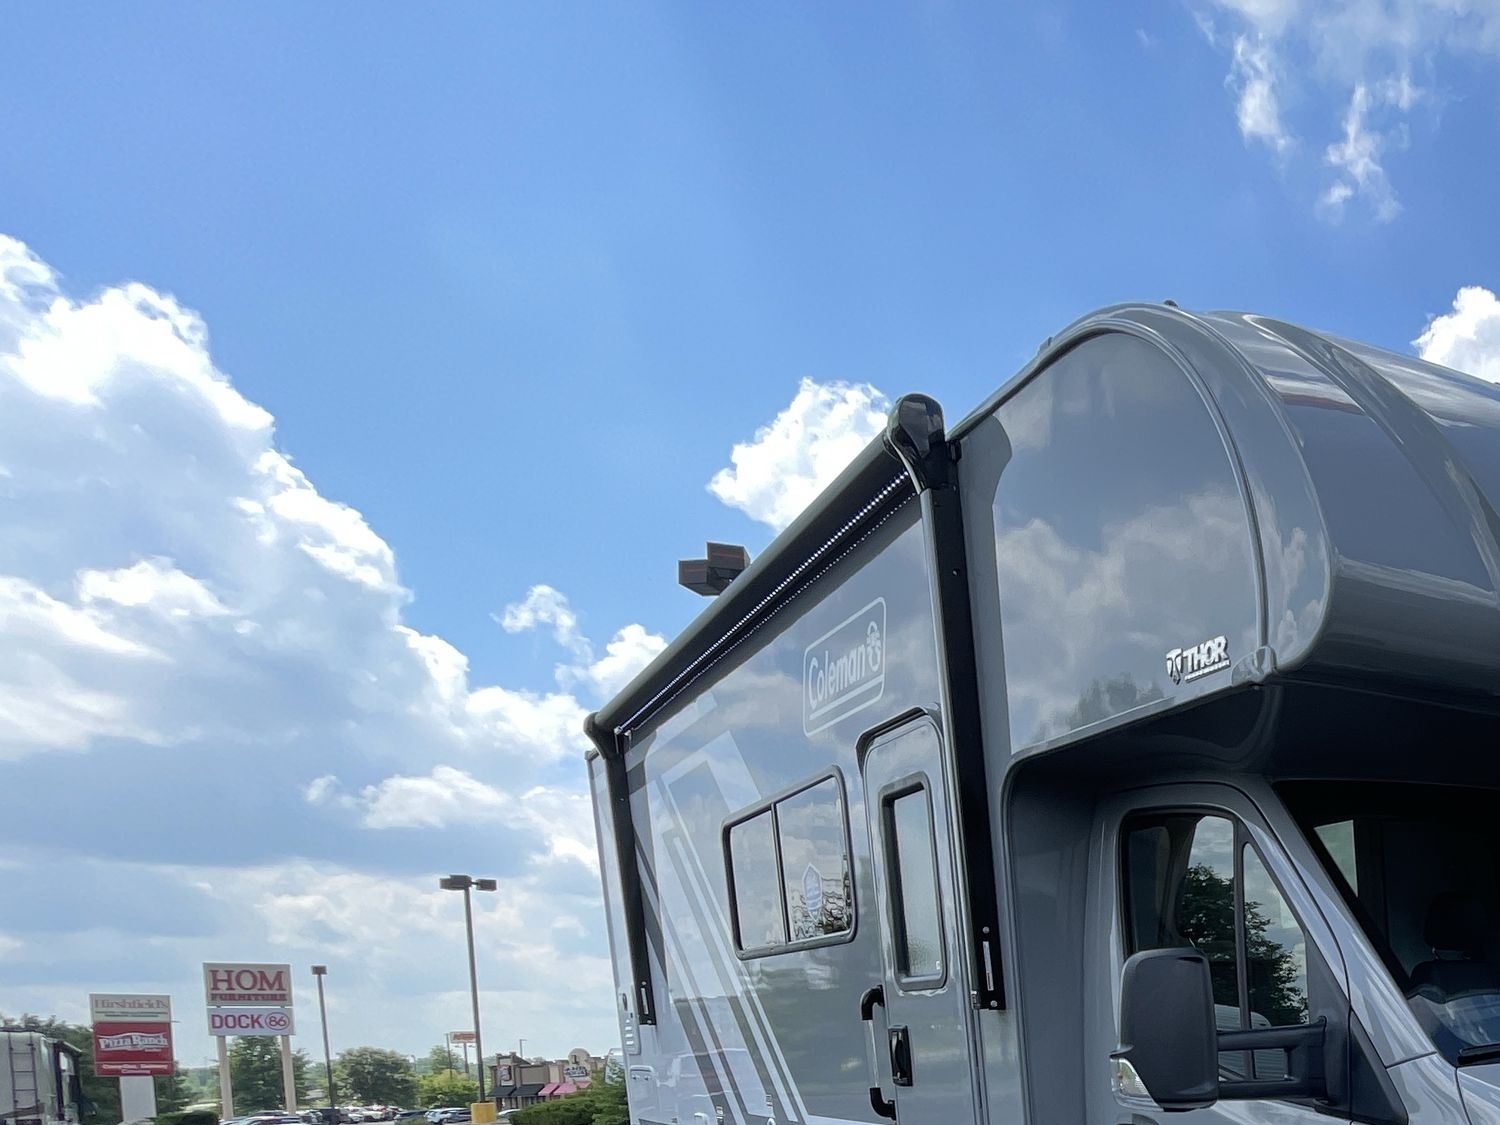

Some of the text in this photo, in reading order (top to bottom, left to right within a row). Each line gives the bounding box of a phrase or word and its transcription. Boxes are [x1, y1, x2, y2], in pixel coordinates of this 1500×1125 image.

[1183, 635, 1229, 673] THOR
[808, 644, 866, 710] Coleman
[209, 970, 286, 991] HOM
[210, 993, 287, 1001] FURNITURE
[211, 1013, 287, 1029] DOCK 86
[99, 1032, 168, 1049] Pizza Ranch
